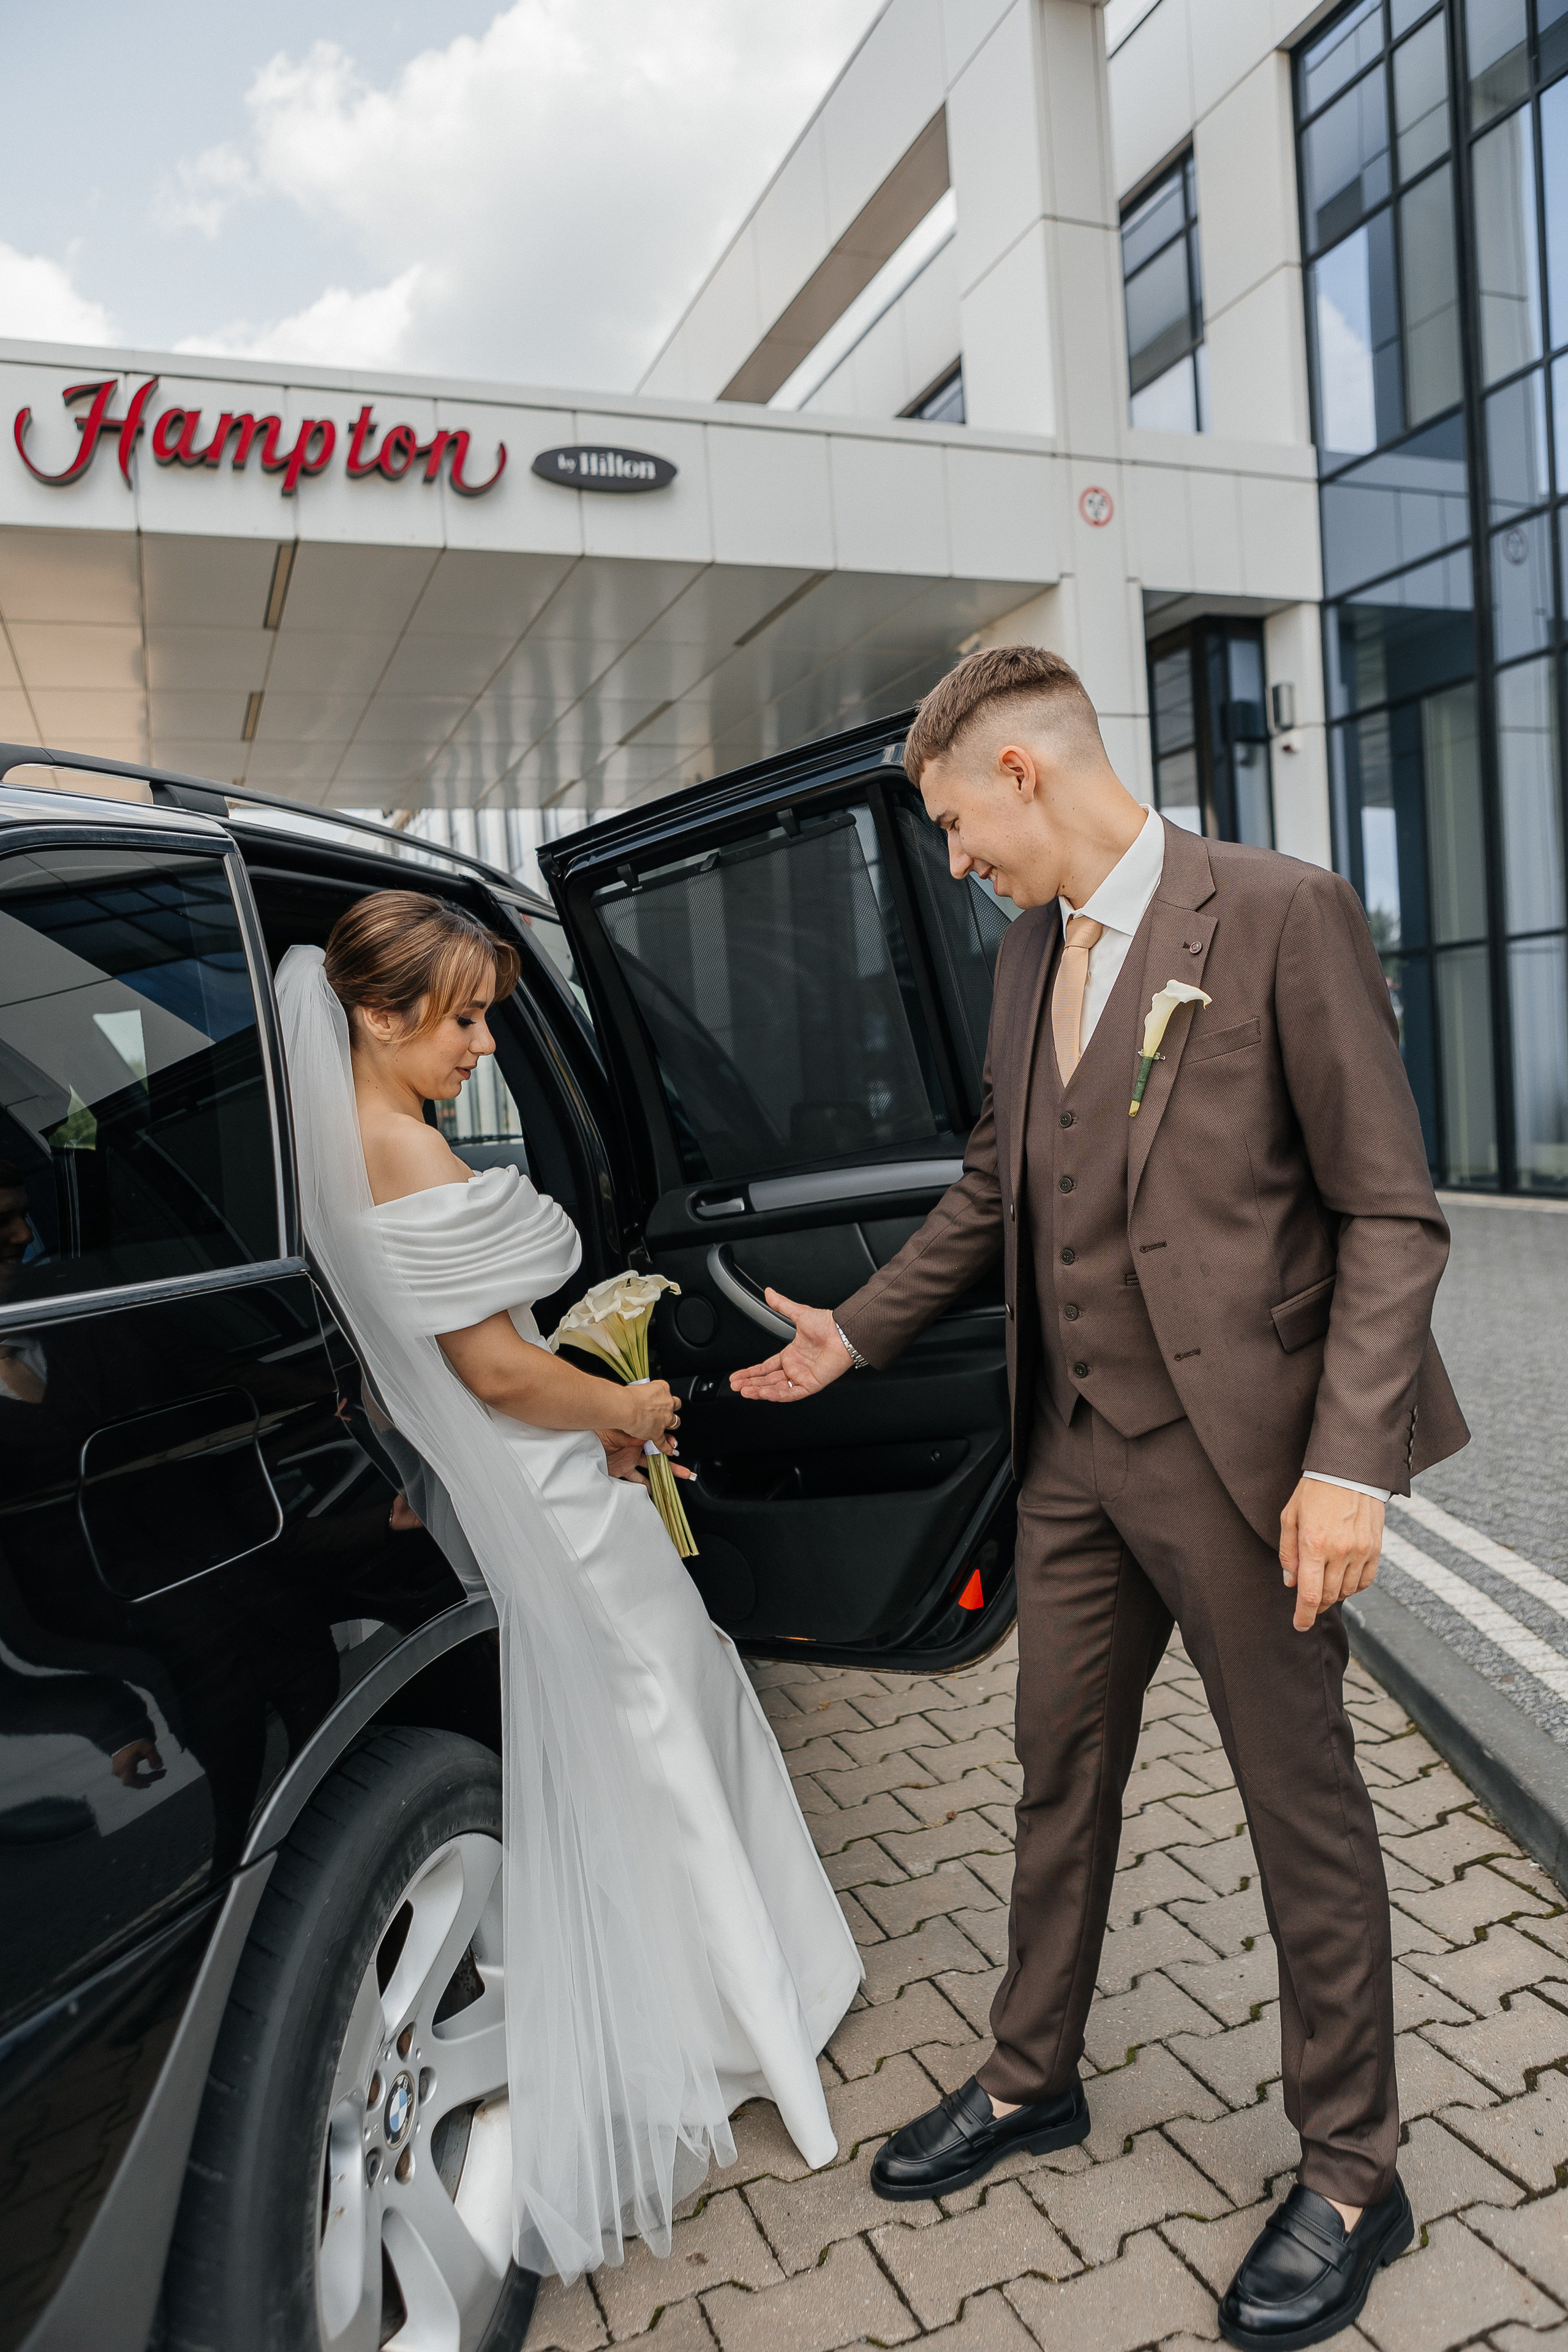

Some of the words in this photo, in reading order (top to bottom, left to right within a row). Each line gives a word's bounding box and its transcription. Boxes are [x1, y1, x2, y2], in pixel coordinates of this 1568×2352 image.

[14, 377, 506, 496] Hampton
[557, 453, 576, 474] by
[579, 452, 656, 480] Hilton
